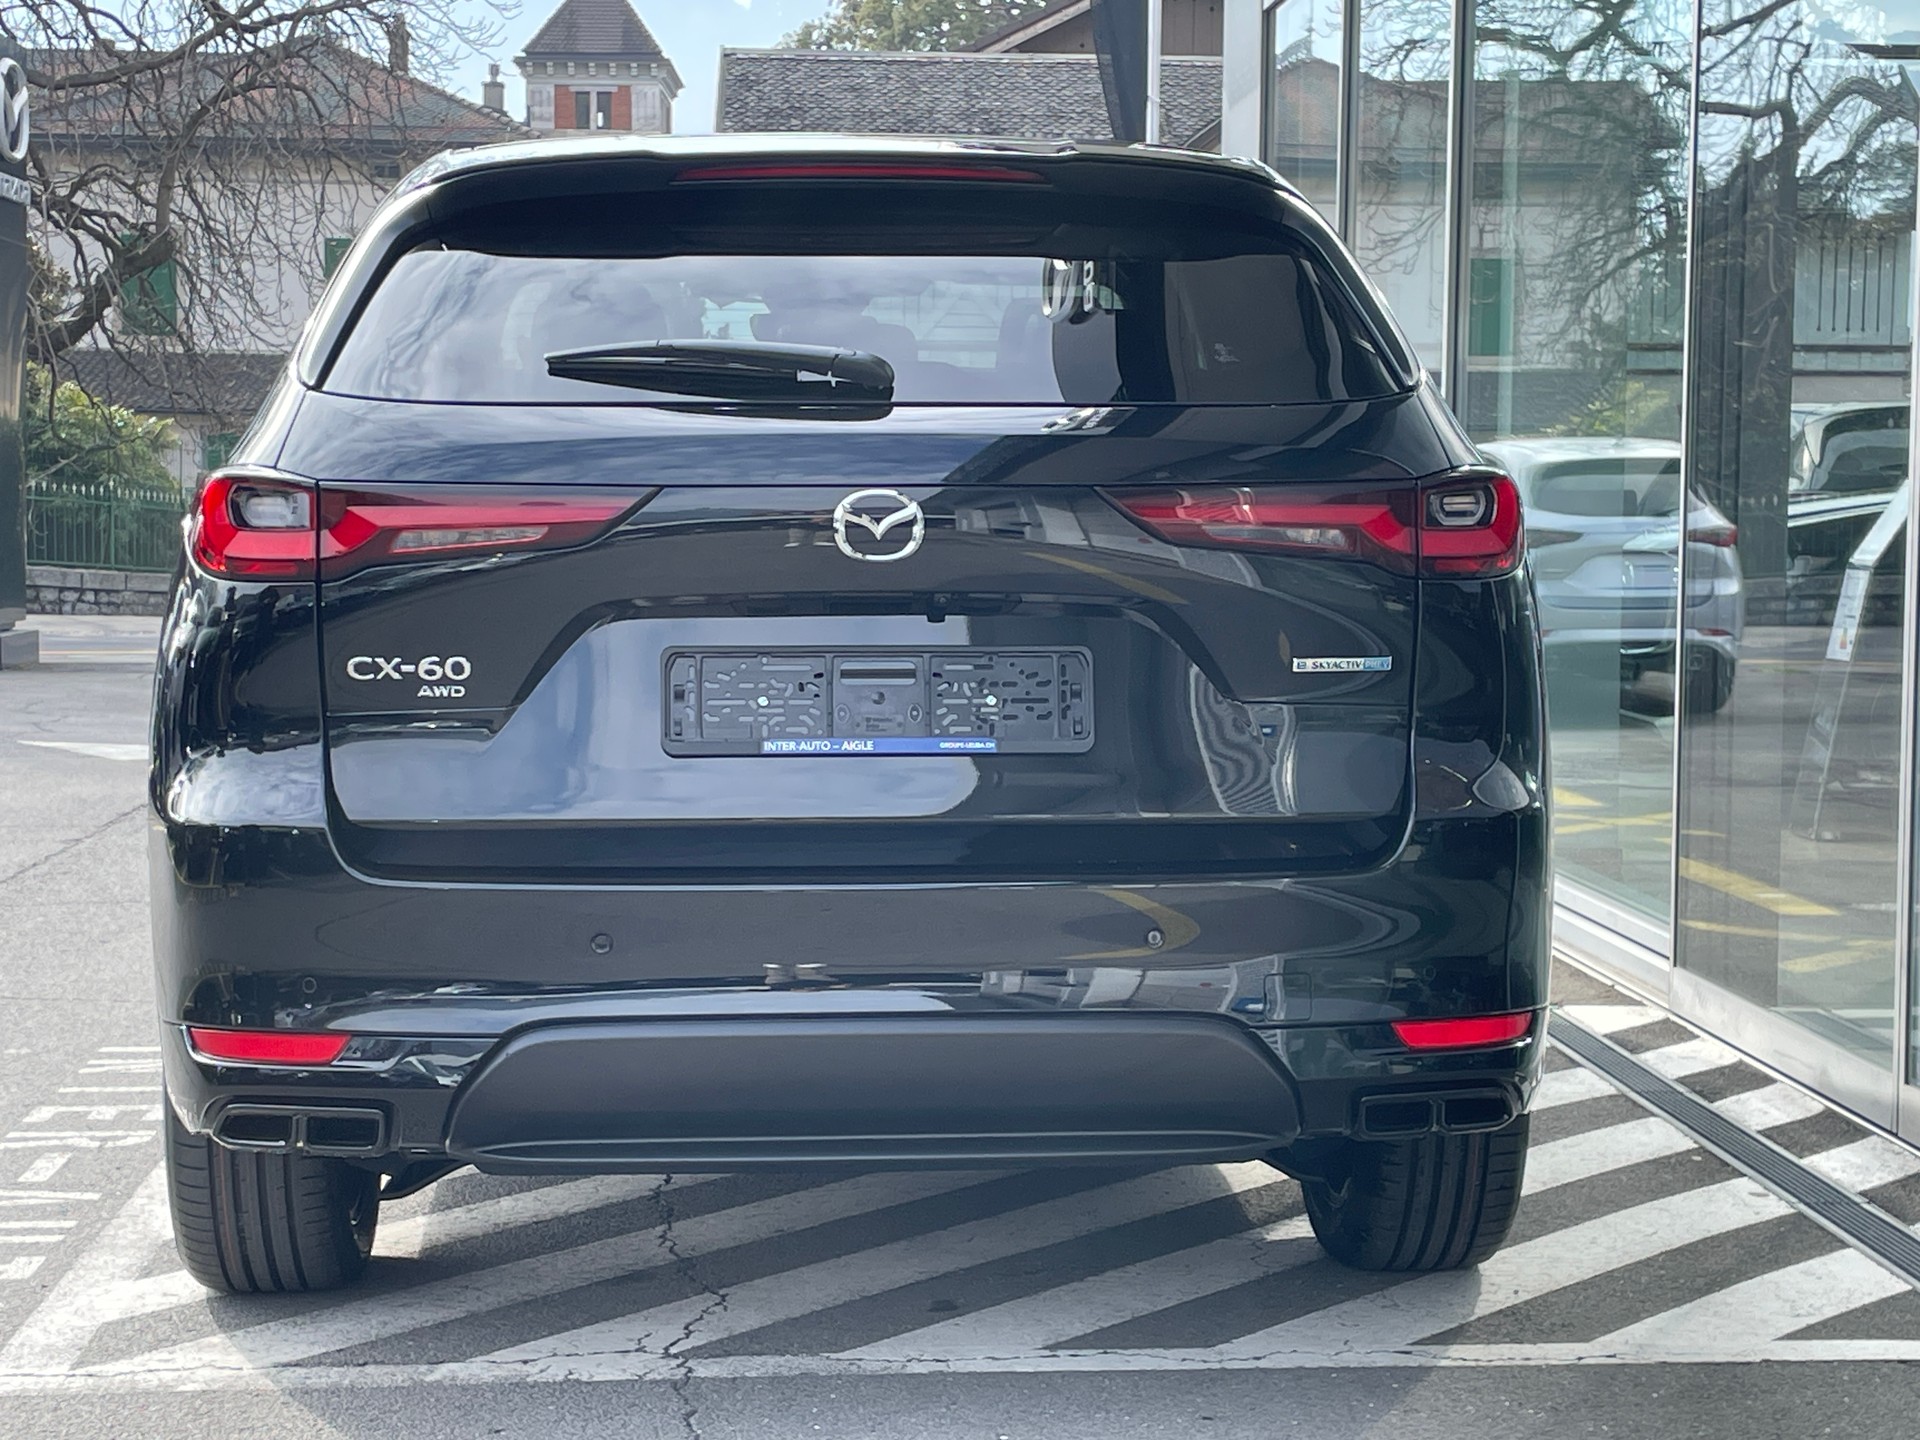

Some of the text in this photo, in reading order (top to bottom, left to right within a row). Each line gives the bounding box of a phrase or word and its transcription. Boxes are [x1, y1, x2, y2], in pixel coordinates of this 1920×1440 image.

[347, 656, 471, 680] CX-60
[1311, 660, 1361, 669] SKYACTIV
[417, 685, 465, 697] AWD
[764, 741, 830, 750] INTER-AUTO
[841, 741, 874, 750] AIGLE
